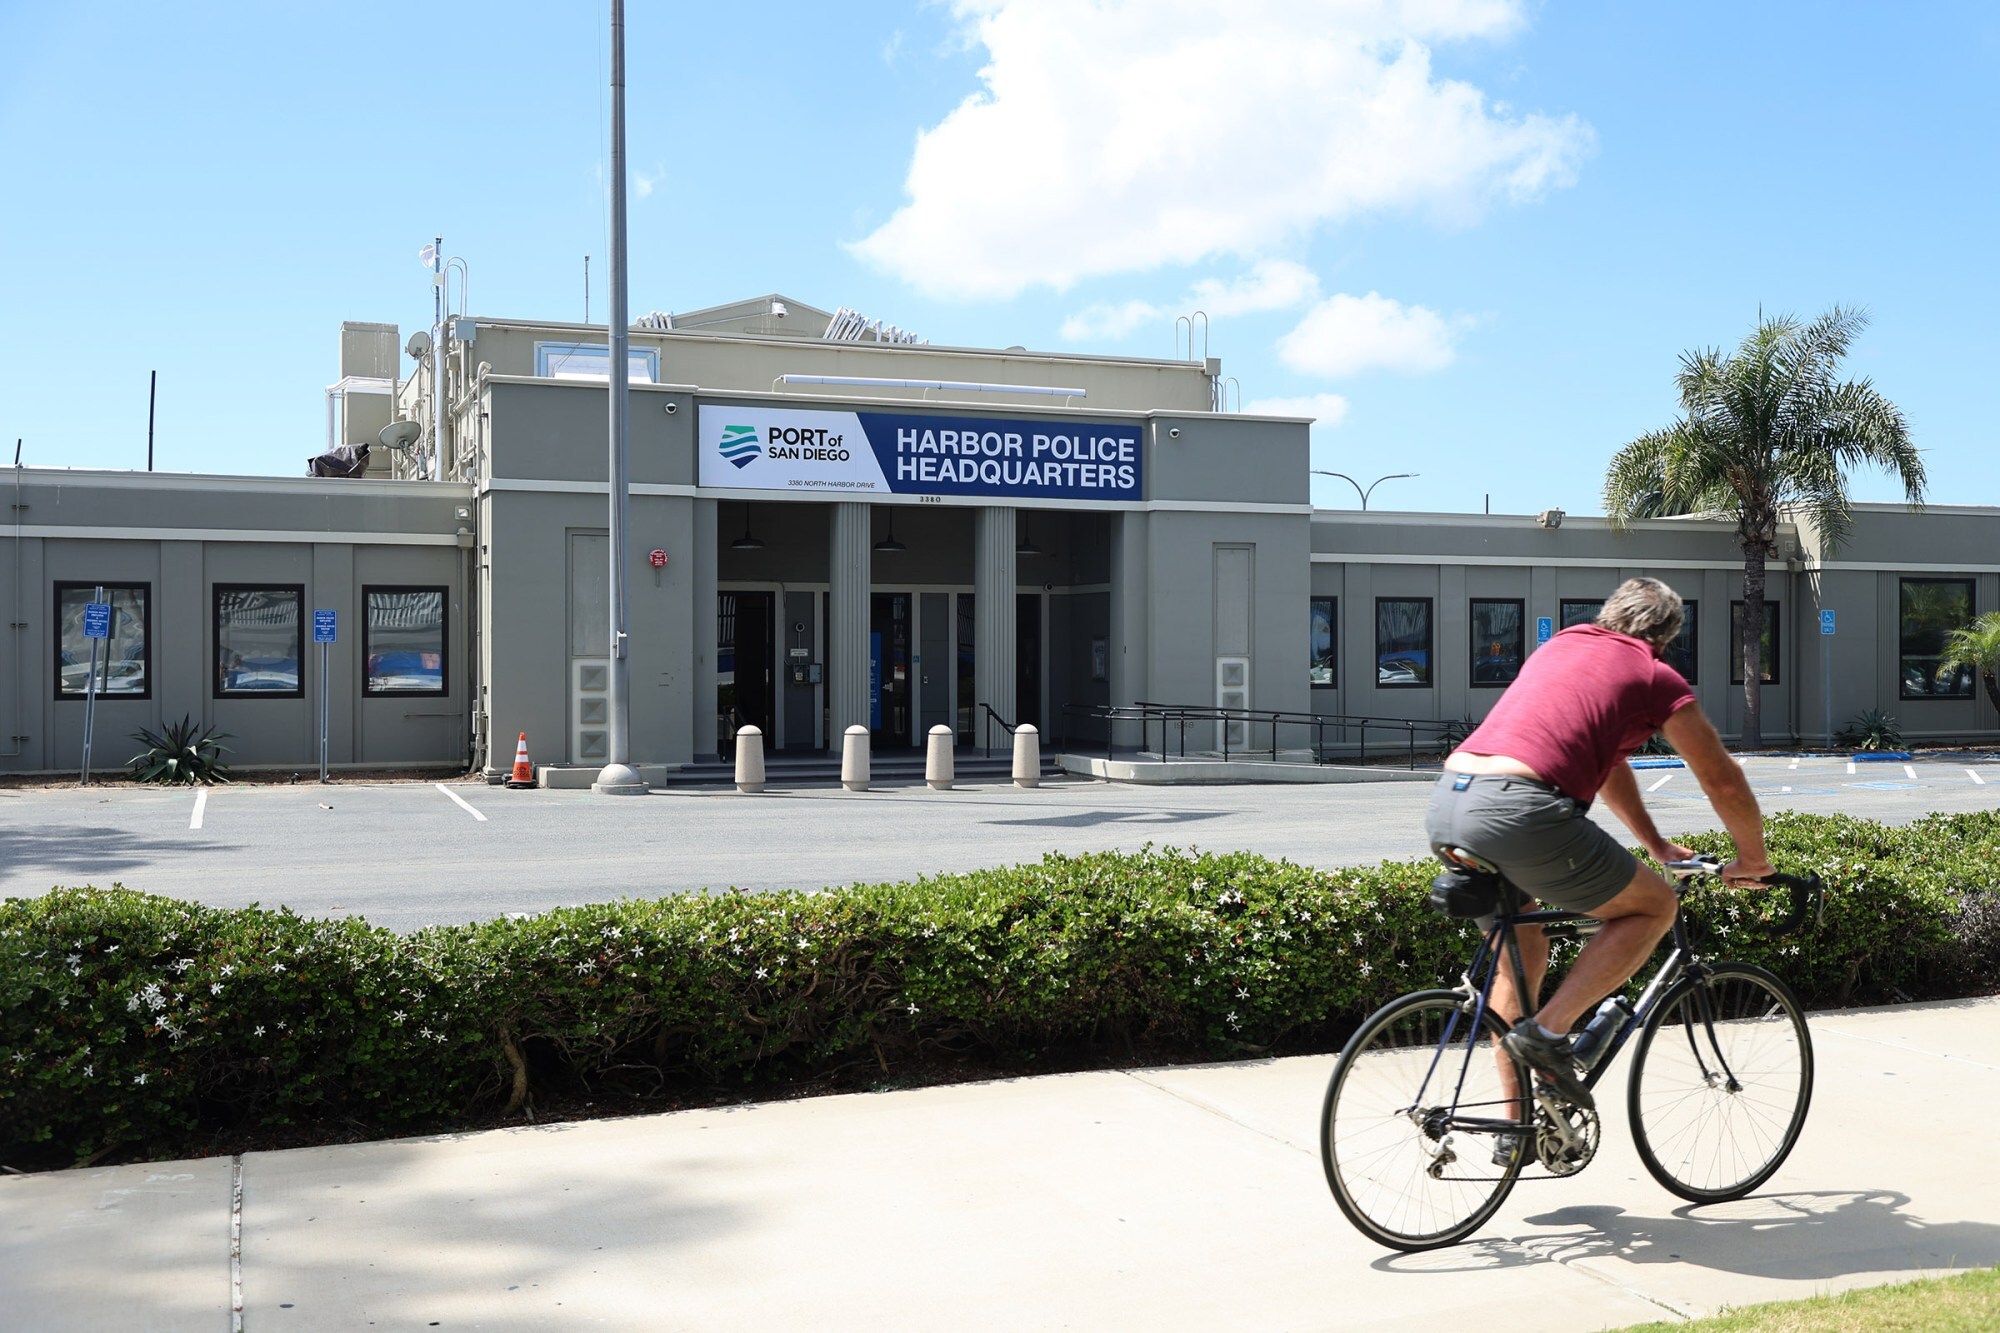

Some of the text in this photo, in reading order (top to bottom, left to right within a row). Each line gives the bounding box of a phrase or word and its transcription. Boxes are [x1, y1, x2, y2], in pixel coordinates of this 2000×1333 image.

[768, 427, 843, 447] PORT of
[897, 428, 1135, 462] HARBOR POLICE
[768, 447, 850, 462] SAN DIEGO
[897, 456, 1135, 489] HEADQUARTERS
